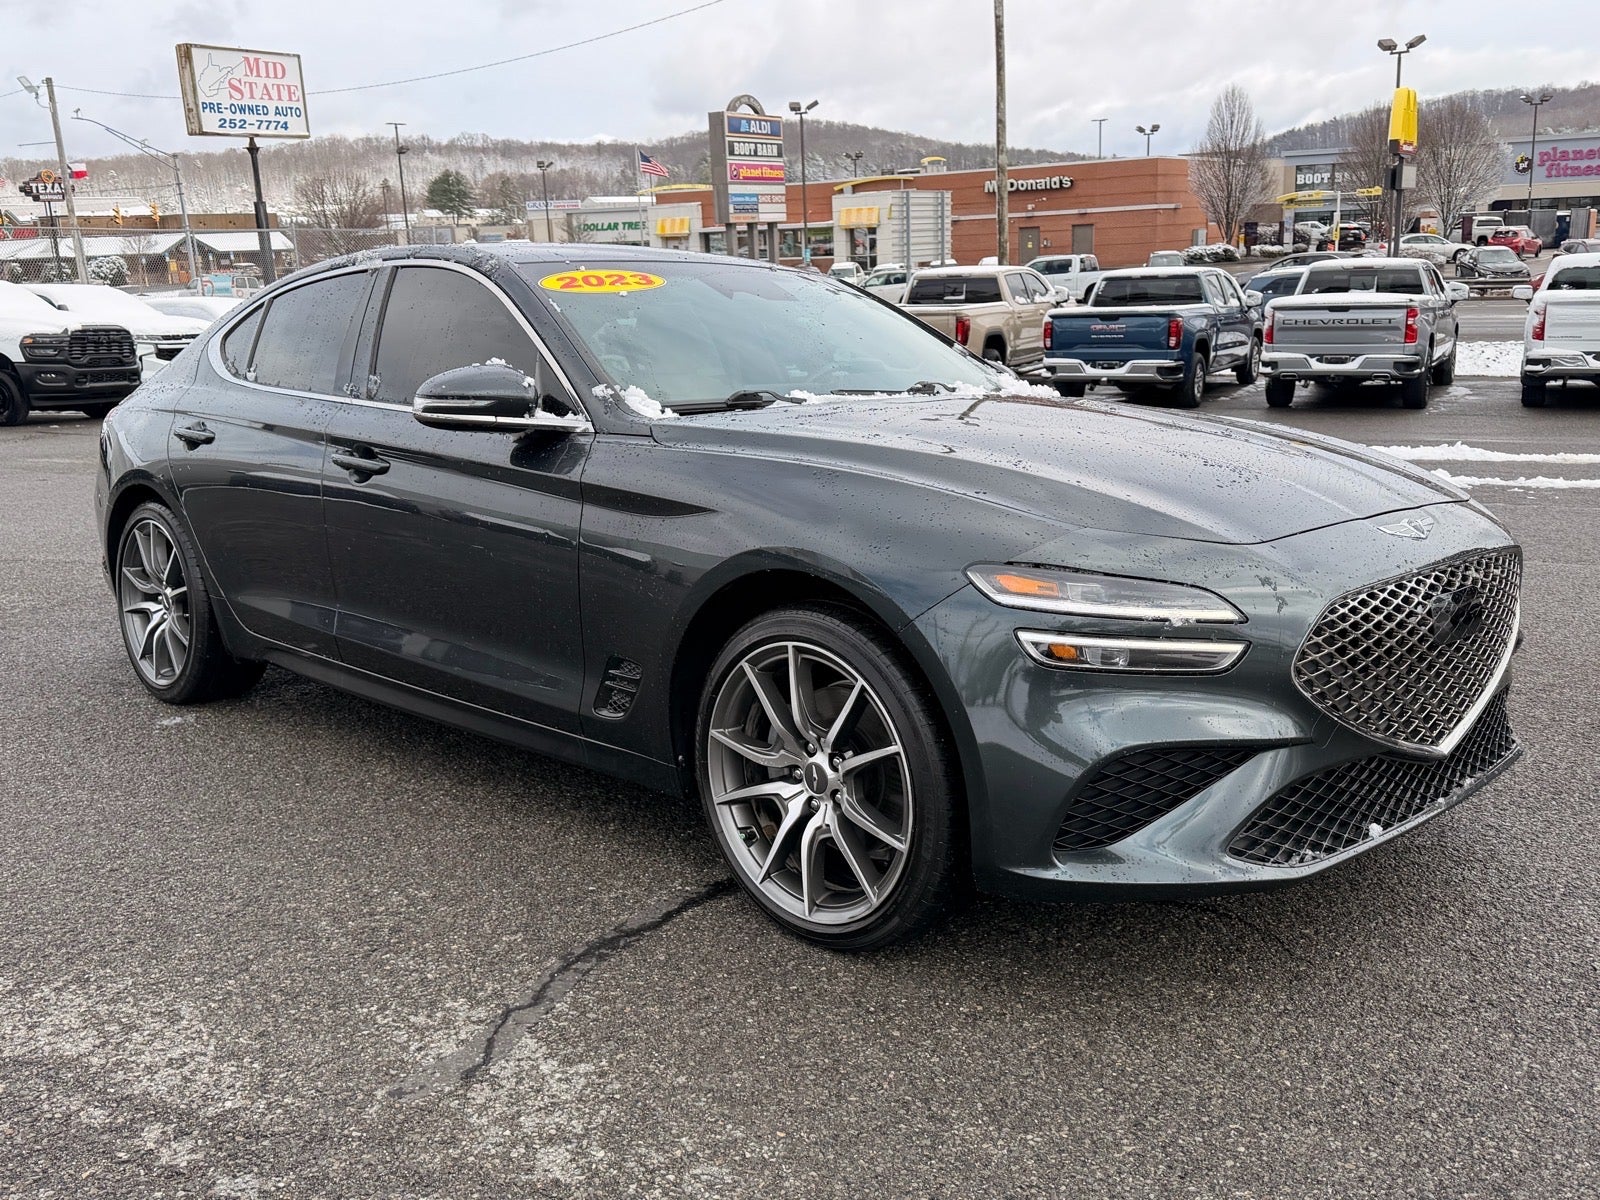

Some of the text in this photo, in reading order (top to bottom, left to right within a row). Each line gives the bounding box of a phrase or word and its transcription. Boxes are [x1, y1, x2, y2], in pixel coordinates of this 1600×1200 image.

[242, 56, 286, 80] MID
[227, 77, 300, 102] STATE
[201, 102, 301, 118] PRE-OWNED AUTO
[218, 118, 289, 131] 252-7774
[750, 120, 771, 134] ALDI
[733, 142, 778, 156] BOOT BARN
[739, 165, 784, 179] planet fitness
[1296, 173, 1331, 185] BOOT
[984, 176, 1072, 192] MDonald's
[582, 222, 620, 231] DOLLAR
[556, 273, 655, 289] 2023
[1090, 324, 1126, 332] GMC
